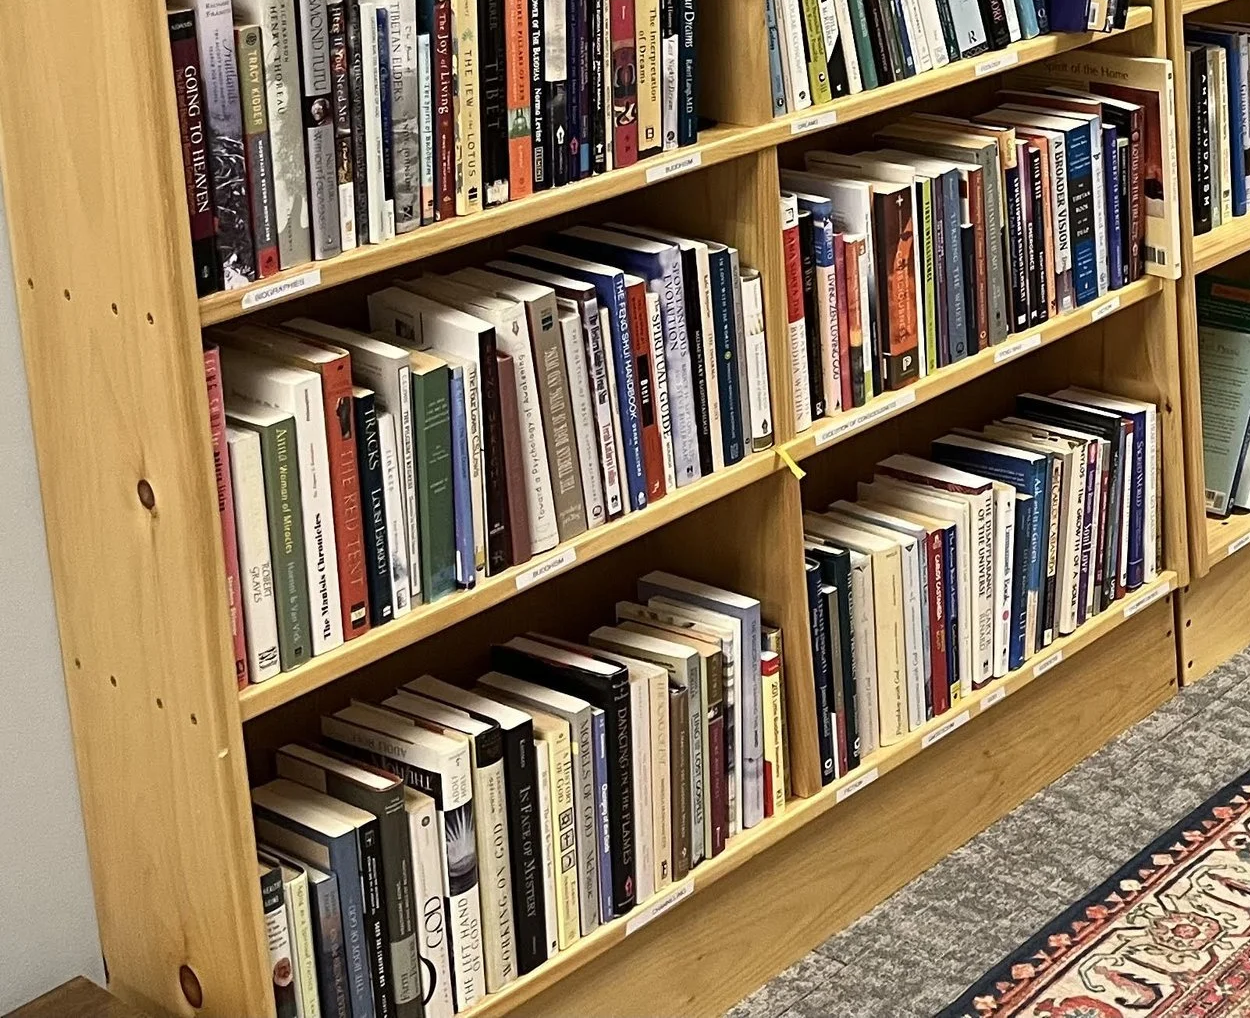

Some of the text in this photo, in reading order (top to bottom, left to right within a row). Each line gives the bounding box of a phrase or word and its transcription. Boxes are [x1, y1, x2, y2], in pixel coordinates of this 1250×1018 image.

[247, 50, 264, 126] TRACY KIDDER
[269, 5, 286, 115] HENRY THOREAU
[312, 53, 327, 92] TUTU
[389, 2, 403, 103] TIBETAN ELDERS
[436, 14, 451, 115] The Joy of Living
[483, 60, 501, 130] TIBET
[638, 30, 648, 85] of Dreams
[648, 7, 659, 103] The Interpretation
[183, 65, 209, 214] GOING TO HEAVEN
[464, 50, 477, 178] THE JEW LOTUS
[665, 158, 694, 174] BUDDHISM
[1054, 141, 1068, 251] A BROADER VISION
[254, 277, 306, 303] BIOGRAPHIES
[663, 274, 678, 352] EVOLUTION
[616, 279, 637, 420] THE FENG SHUI HANDBOOK
[274, 428, 295, 555] Anna Woman of Miracles
[339, 449, 363, 587] THE RED TENT
[363, 405, 388, 575] TRACKS LOUISE ERDRICH
[250, 566, 262, 604] GRAVES
[261, 563, 272, 598] ROBERT
[978, 509, 987, 598] OF THE UNIVERSE
[984, 520, 993, 600] DISAPPEARANCE
[580, 719, 594, 839] MODELS OF GOD
[423, 896, 443, 948] GOD
[457, 897, 474, 1004] THE LEFT HAND
